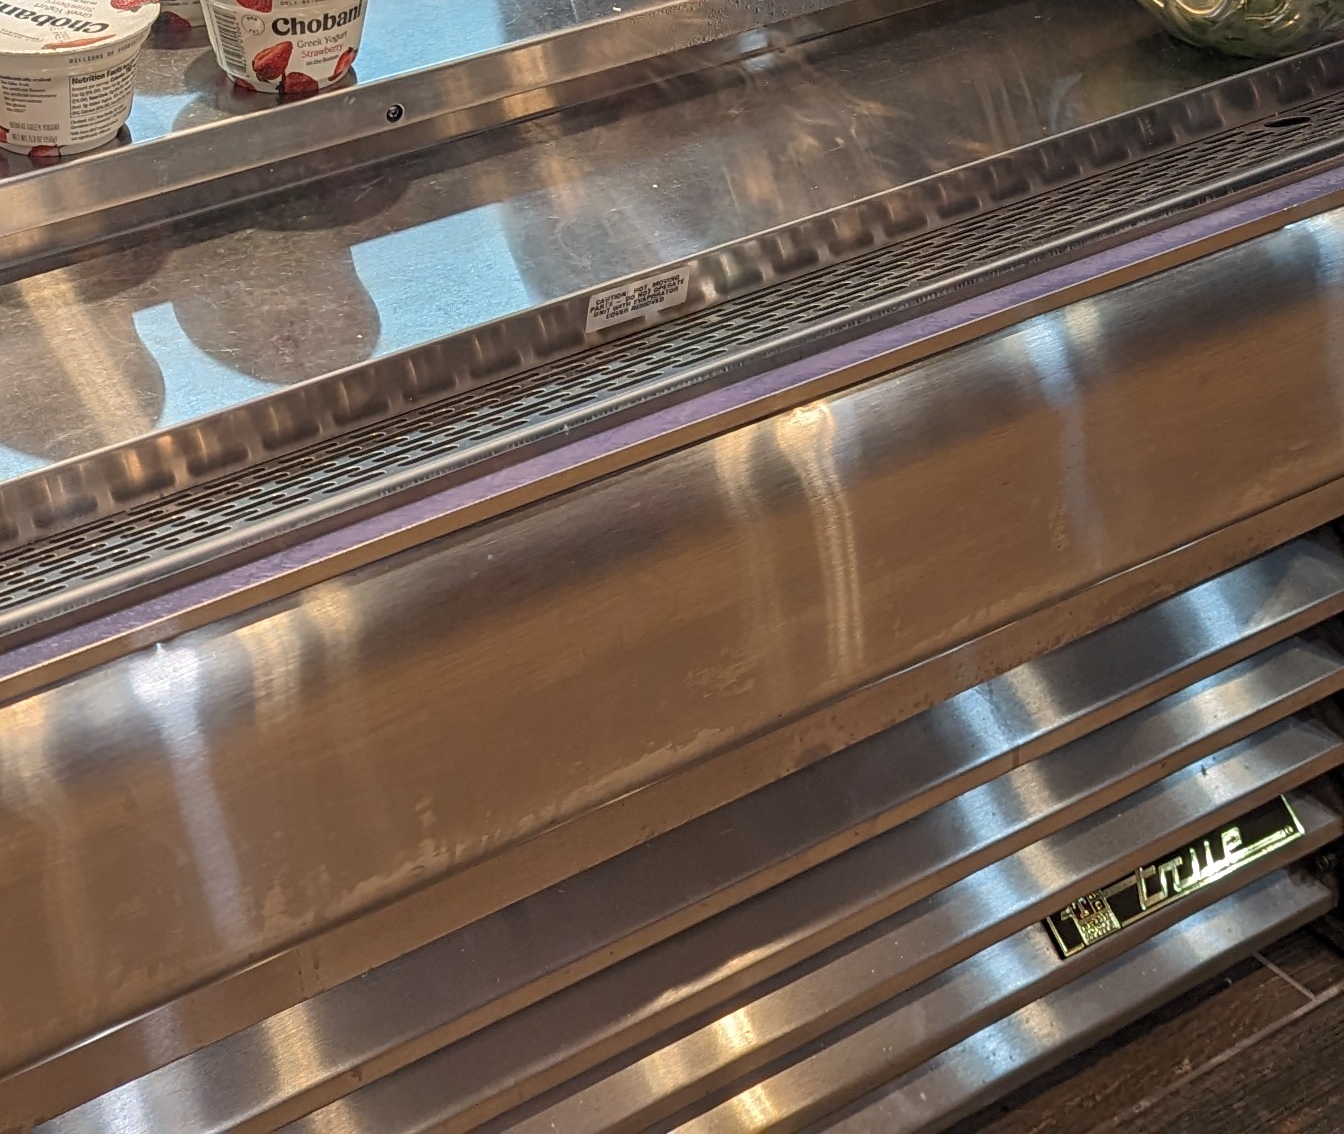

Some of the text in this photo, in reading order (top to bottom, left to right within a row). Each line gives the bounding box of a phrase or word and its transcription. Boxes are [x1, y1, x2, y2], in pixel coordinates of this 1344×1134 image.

[297, 31, 348, 49] Greek Yogurt
[301, 43, 344, 58] Strawberry
[72, 73, 105, 85] Nutrition
